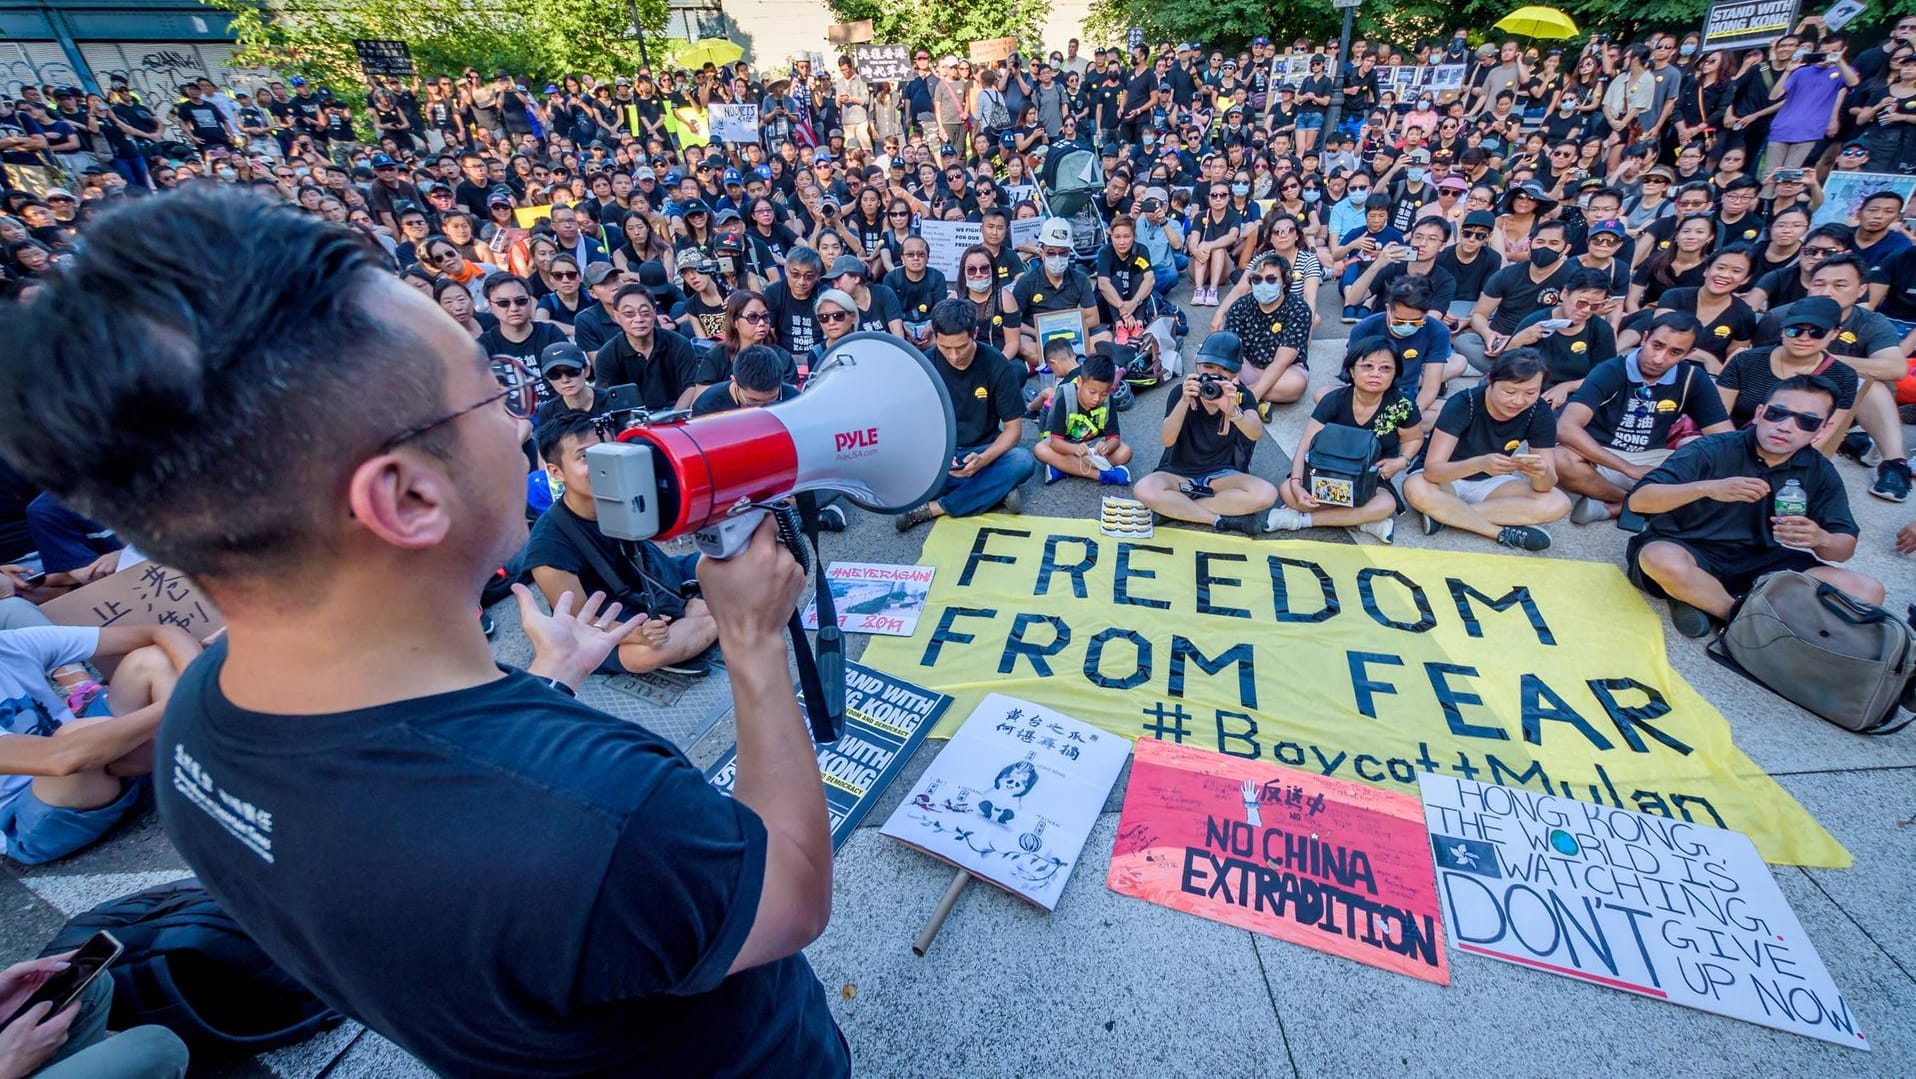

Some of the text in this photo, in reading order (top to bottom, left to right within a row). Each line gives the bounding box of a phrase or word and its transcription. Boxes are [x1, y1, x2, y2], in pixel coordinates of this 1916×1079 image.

[1709, 18, 1748, 32] HONG
[1749, 12, 1790, 28] KONG
[1711, 0, 1794, 21] STAND WITH
[835, 427, 878, 452] PYLE
[1615, 432, 1649, 445] HONG
[957, 527, 1557, 646] FREEDOM
[882, 683, 936, 715] WITH
[920, 607, 1695, 757] FROM FEAR
[862, 697, 921, 733] KONG
[873, 717, 910, 737] DEMOCRACY
[818, 750, 877, 791] KONG
[835, 733, 894, 771] WITH
[826, 774, 864, 796] DEMOCRACY
[1260, 778, 1327, 817] 反送中
[1457, 778, 1571, 828] HONG
[1205, 814, 1254, 857] NO
[1262, 827, 1379, 896] CHINA
[1426, 803, 1504, 845] THE
[1519, 821, 1661, 875] WORLD
[1181, 846, 1439, 966] EXTRADITION
[1443, 871, 1661, 989] DON'T
[1661, 918, 1806, 981] GIVE
[1678, 957, 1736, 1001] UP
